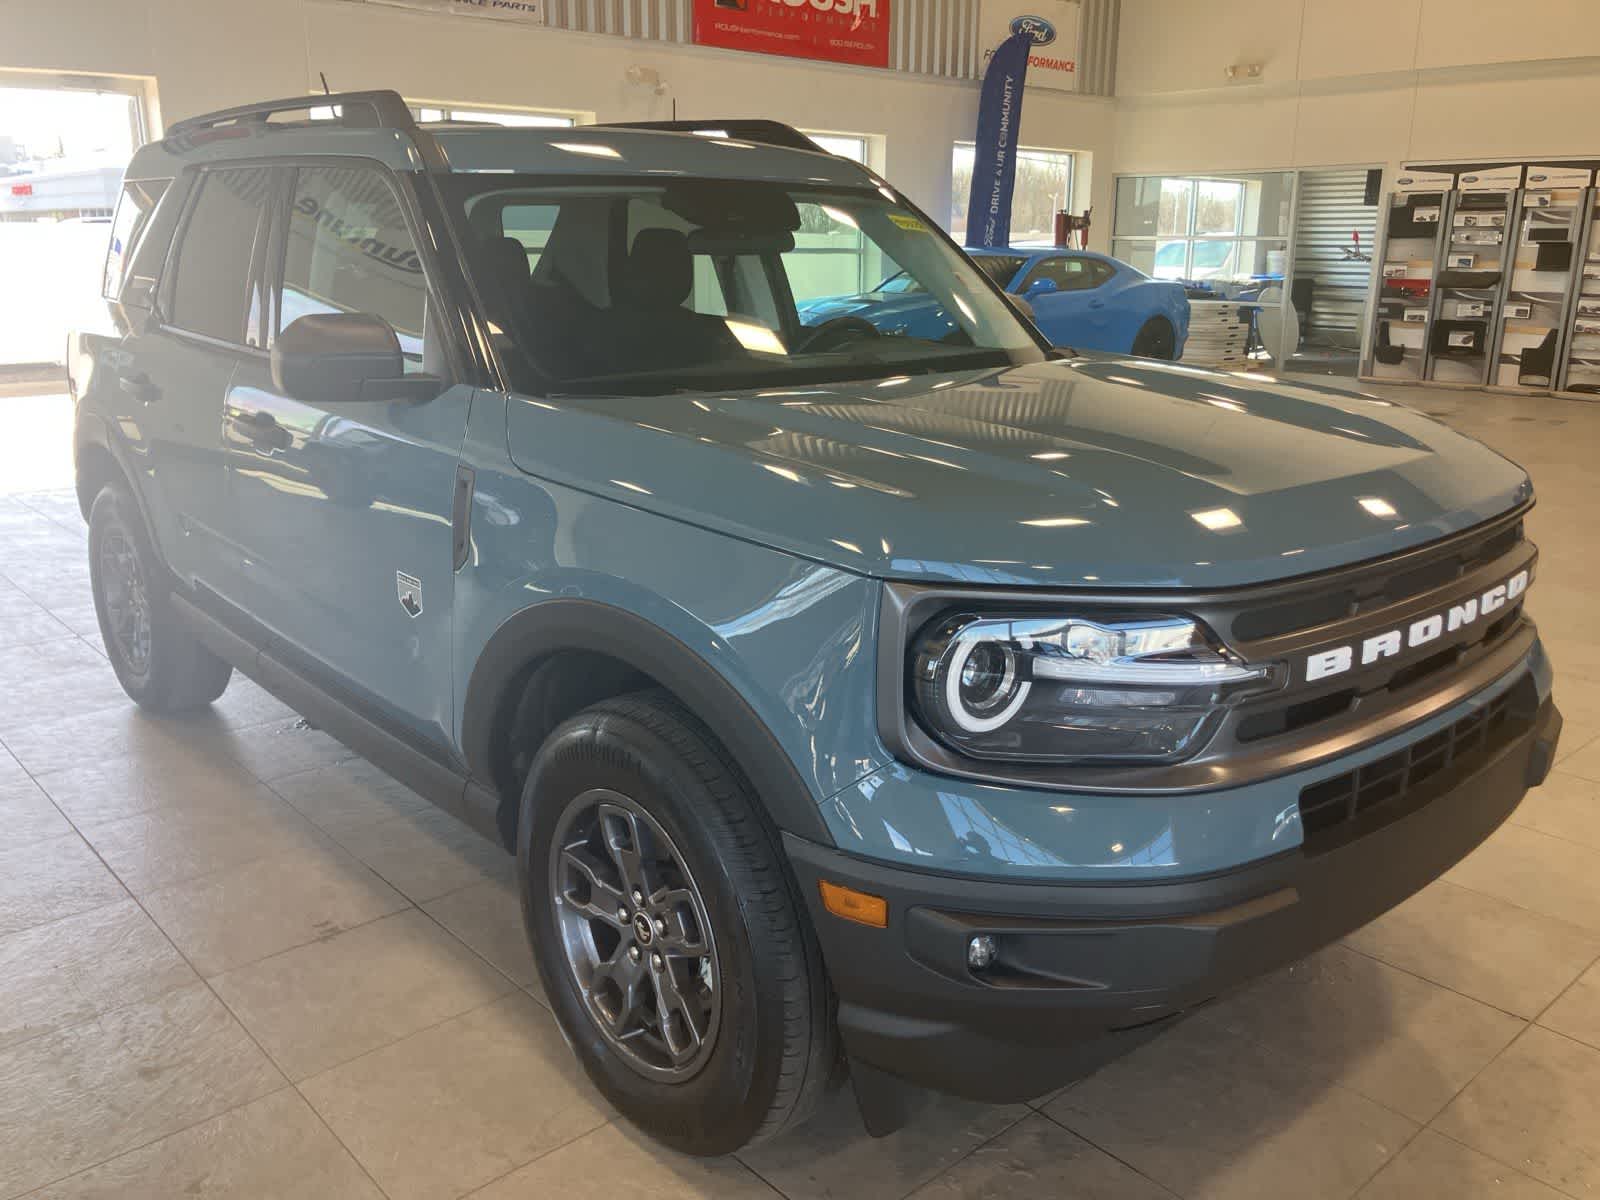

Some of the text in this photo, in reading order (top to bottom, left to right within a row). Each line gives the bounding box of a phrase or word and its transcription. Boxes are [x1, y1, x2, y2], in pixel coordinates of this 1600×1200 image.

[493, 0, 536, 12] PARTS
[1027, 55, 1075, 72] FORMANCE
[989, 178, 1001, 214] DRIVE
[984, 218, 996, 248] Ford
[1306, 570, 1529, 682] BRONCO
